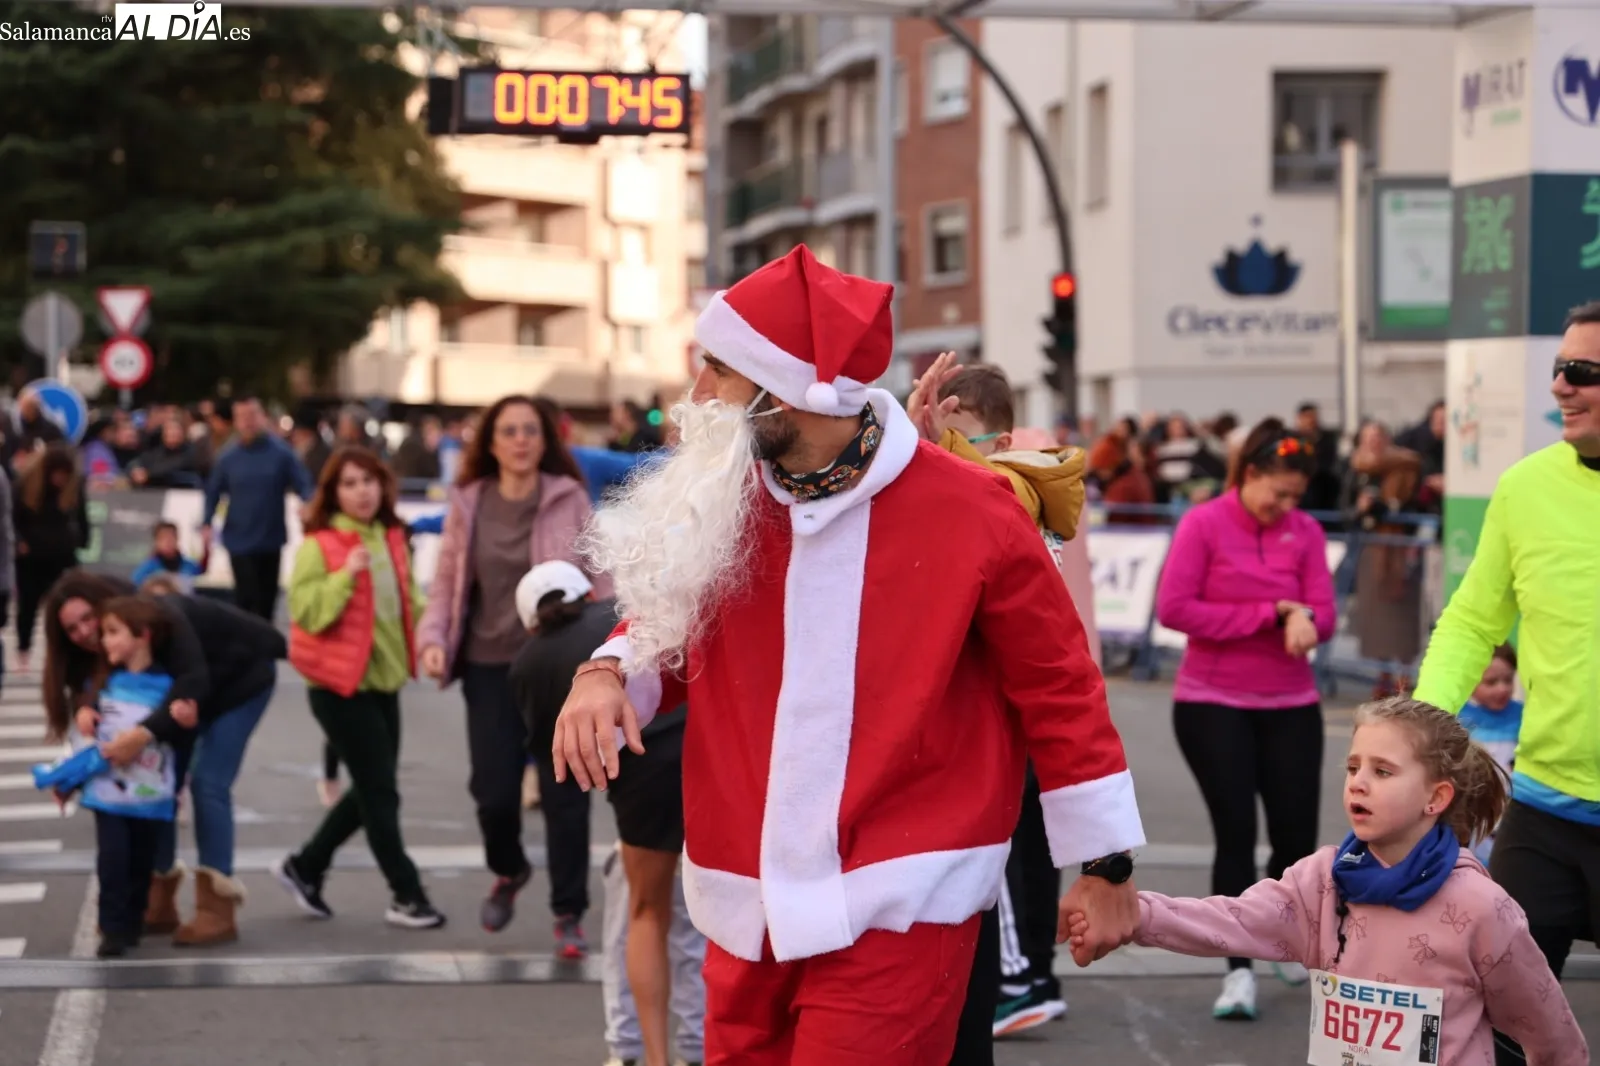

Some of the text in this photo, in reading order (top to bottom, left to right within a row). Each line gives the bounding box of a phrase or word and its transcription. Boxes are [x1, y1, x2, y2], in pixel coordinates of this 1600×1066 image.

[1339, 982, 1427, 1010] SETEL
[1323, 999, 1405, 1052] 6672
[1347, 1044, 1370, 1056] NORA
